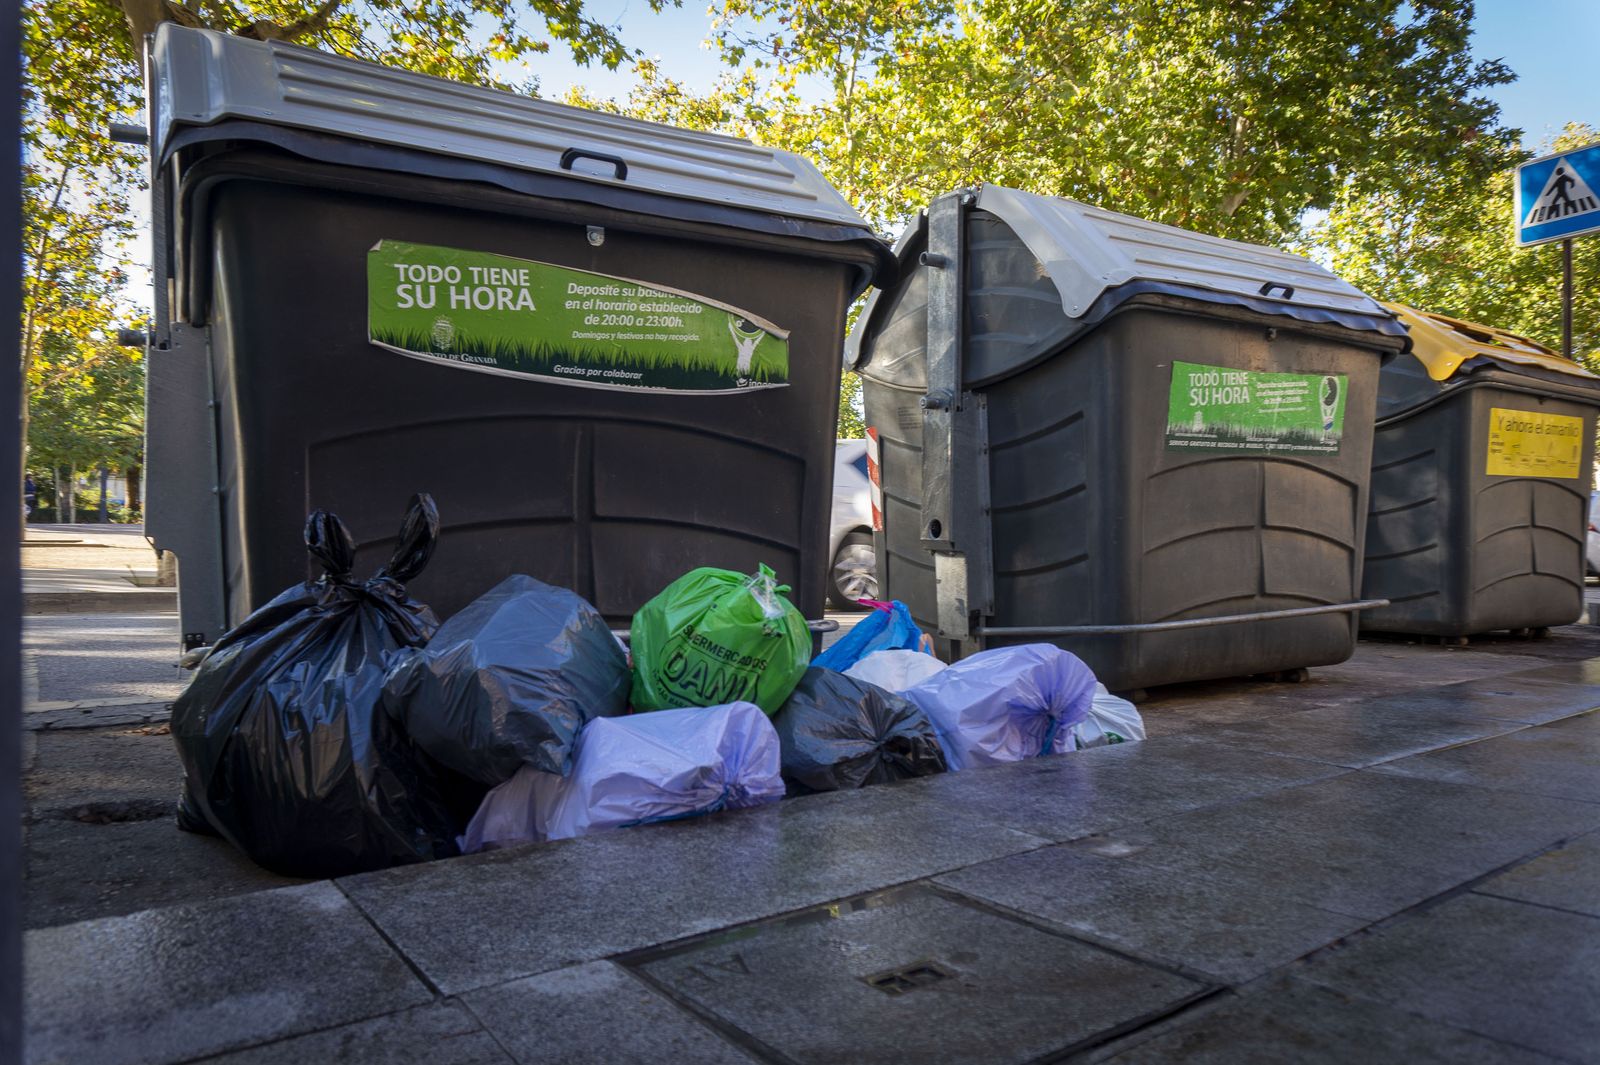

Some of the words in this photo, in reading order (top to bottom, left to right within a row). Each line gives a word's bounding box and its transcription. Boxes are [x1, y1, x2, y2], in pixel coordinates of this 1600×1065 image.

[394, 263, 461, 284] TODO
[468, 266, 531, 287] TIENE
[396, 283, 436, 309] SU
[449, 285, 537, 311] HORA
[567, 282, 620, 297] Deposite
[621, 286, 636, 297] su
[565, 300, 580, 309] en
[582, 299, 593, 310] el
[595, 300, 637, 312] horario
[639, 301, 703, 314] establecido
[584, 313, 600, 325] de
[601, 314, 634, 326] 20:00
[635, 317, 644, 327] a
[645, 315, 685, 328] 23:00h.
[571, 331, 610, 341] Domingos
[610, 333, 616, 341] y
[616, 331, 644, 341] festivos
[644, 333, 654, 341] no
[655, 333, 669, 342] hay
[553, 364, 586, 377] Gracias
[586, 368, 603, 379] por
[603, 369, 643, 380] colaborar
[1188, 372, 1220, 387] TODO
[1222, 371, 1249, 386] TIENE
[1189, 388, 1209, 407] SU
[1212, 386, 1251, 405] HORA
[1505, 416, 1534, 433] ahora
